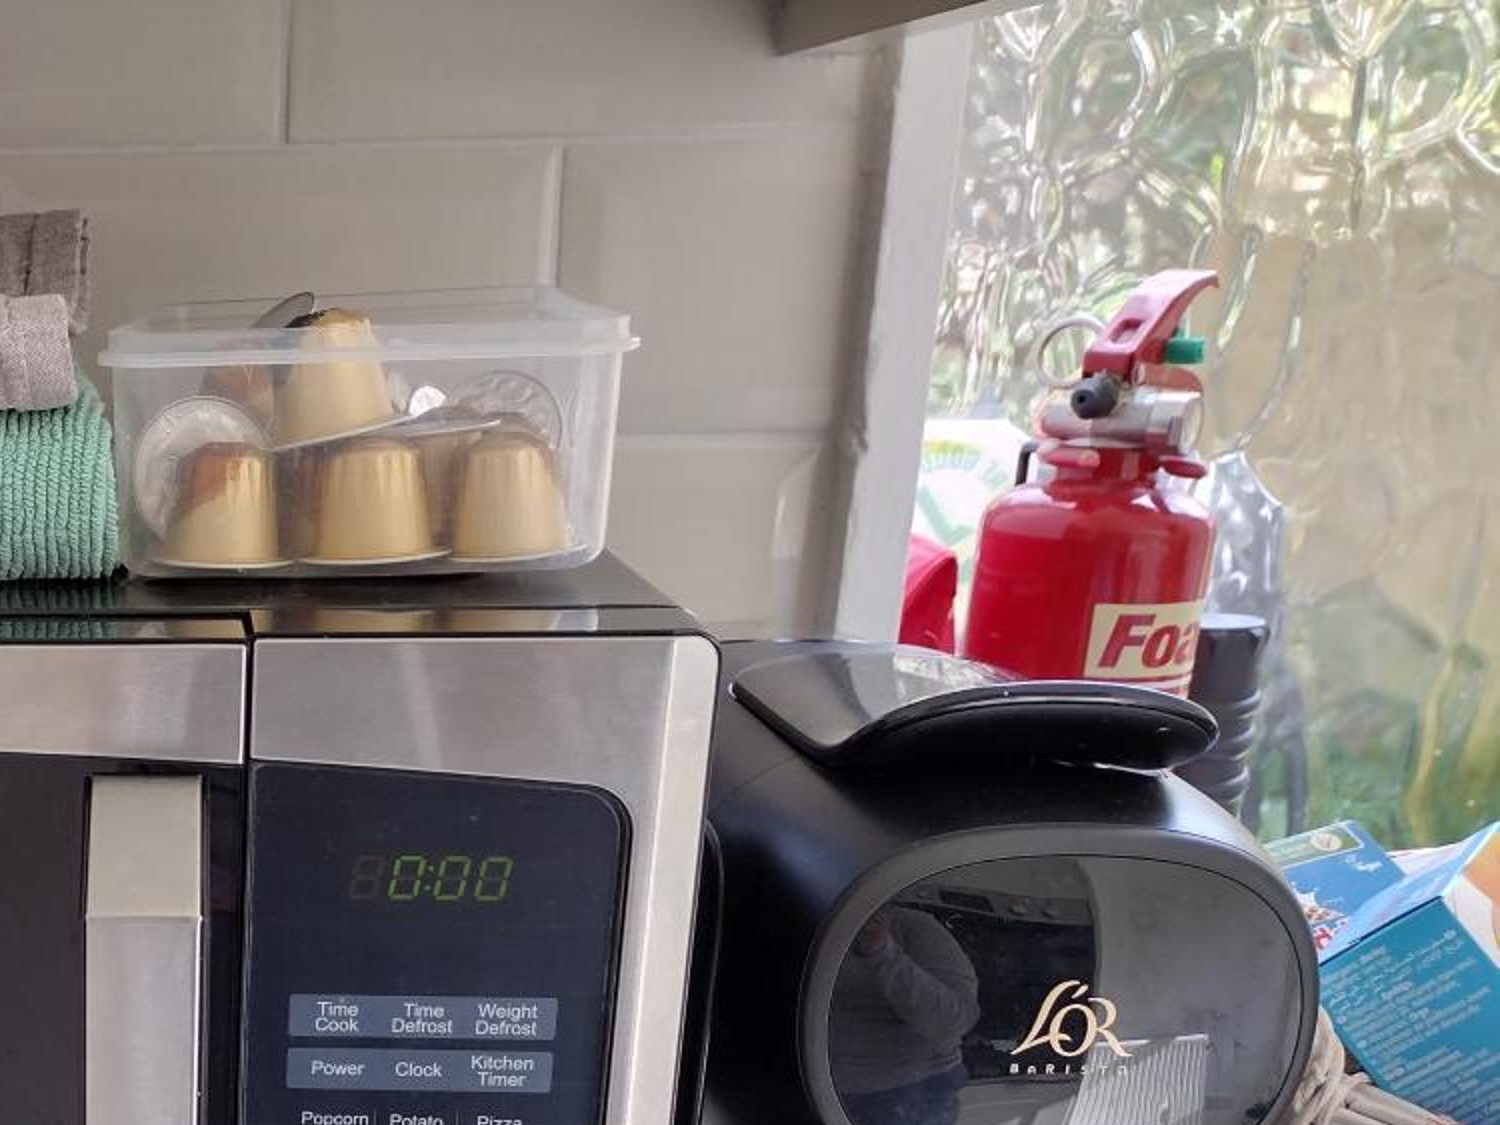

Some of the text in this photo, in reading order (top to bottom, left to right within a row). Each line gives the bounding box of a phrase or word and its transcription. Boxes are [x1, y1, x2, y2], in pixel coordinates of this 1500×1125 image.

[388, 855, 514, 901] 0:00
[316, 1001, 358, 1017] Time
[404, 1003, 445, 1019] Time
[478, 1003, 538, 1021] Weight
[315, 1017, 359, 1032] Cook
[391, 1018, 453, 1034] Defrost
[475, 1020, 537, 1037] Defrost
[310, 1060, 365, 1076] Power
[395, 1061, 442, 1078] Clock
[471, 1056, 534, 1072] Kitchen
[478, 1072, 527, 1088] Timer
